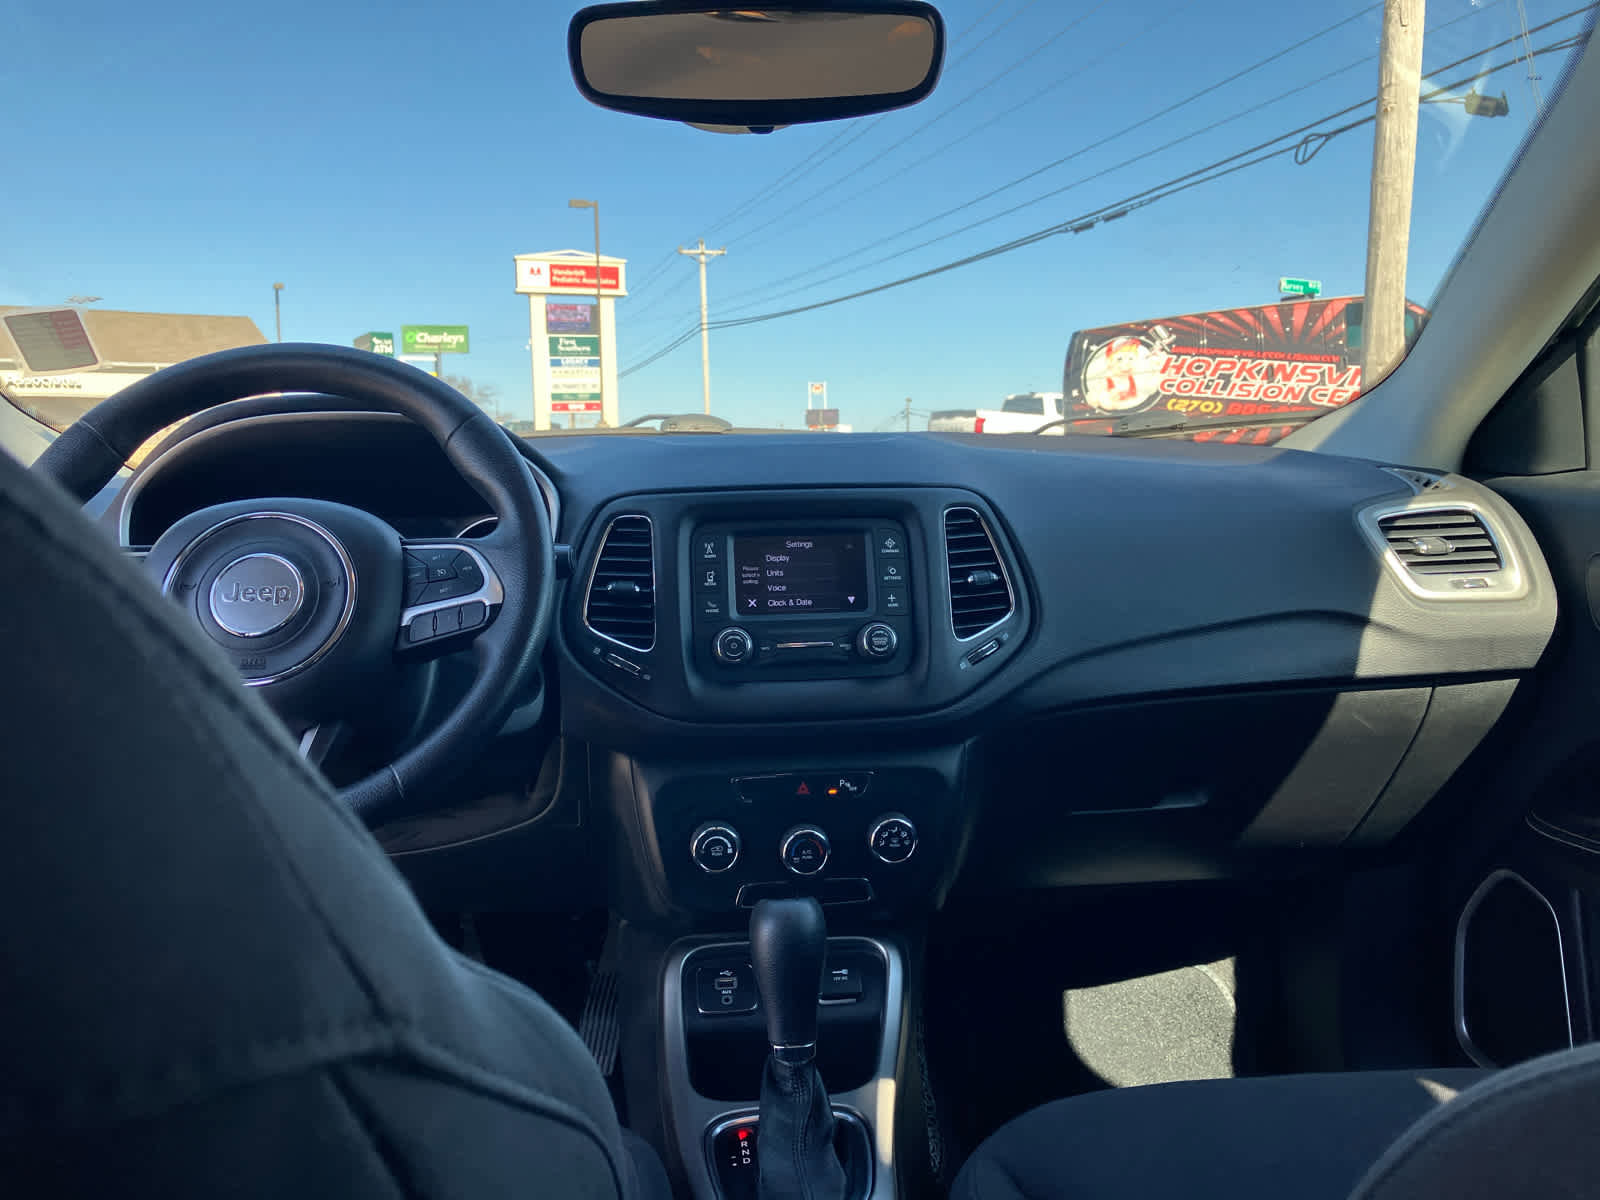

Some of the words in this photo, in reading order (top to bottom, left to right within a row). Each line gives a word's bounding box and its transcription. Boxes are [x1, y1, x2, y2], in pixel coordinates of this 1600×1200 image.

[1158, 353, 1362, 388] HOPKINSVI
[1158, 377, 1307, 403] COLLISION
[1166, 398, 1223, 416] (270)
[785, 540, 813, 550] Settings
[765, 554, 790, 563] Display
[766, 569, 784, 577] Units
[767, 584, 787, 592] Voice
[221, 582, 294, 606] Jeep
[767, 599, 787, 607] Clock
[789, 598, 795, 607] &
[796, 598, 813, 607] Date
[741, 1140, 748, 1148] R
[742, 1149, 750, 1157] N
[743, 1157, 751, 1165] D
